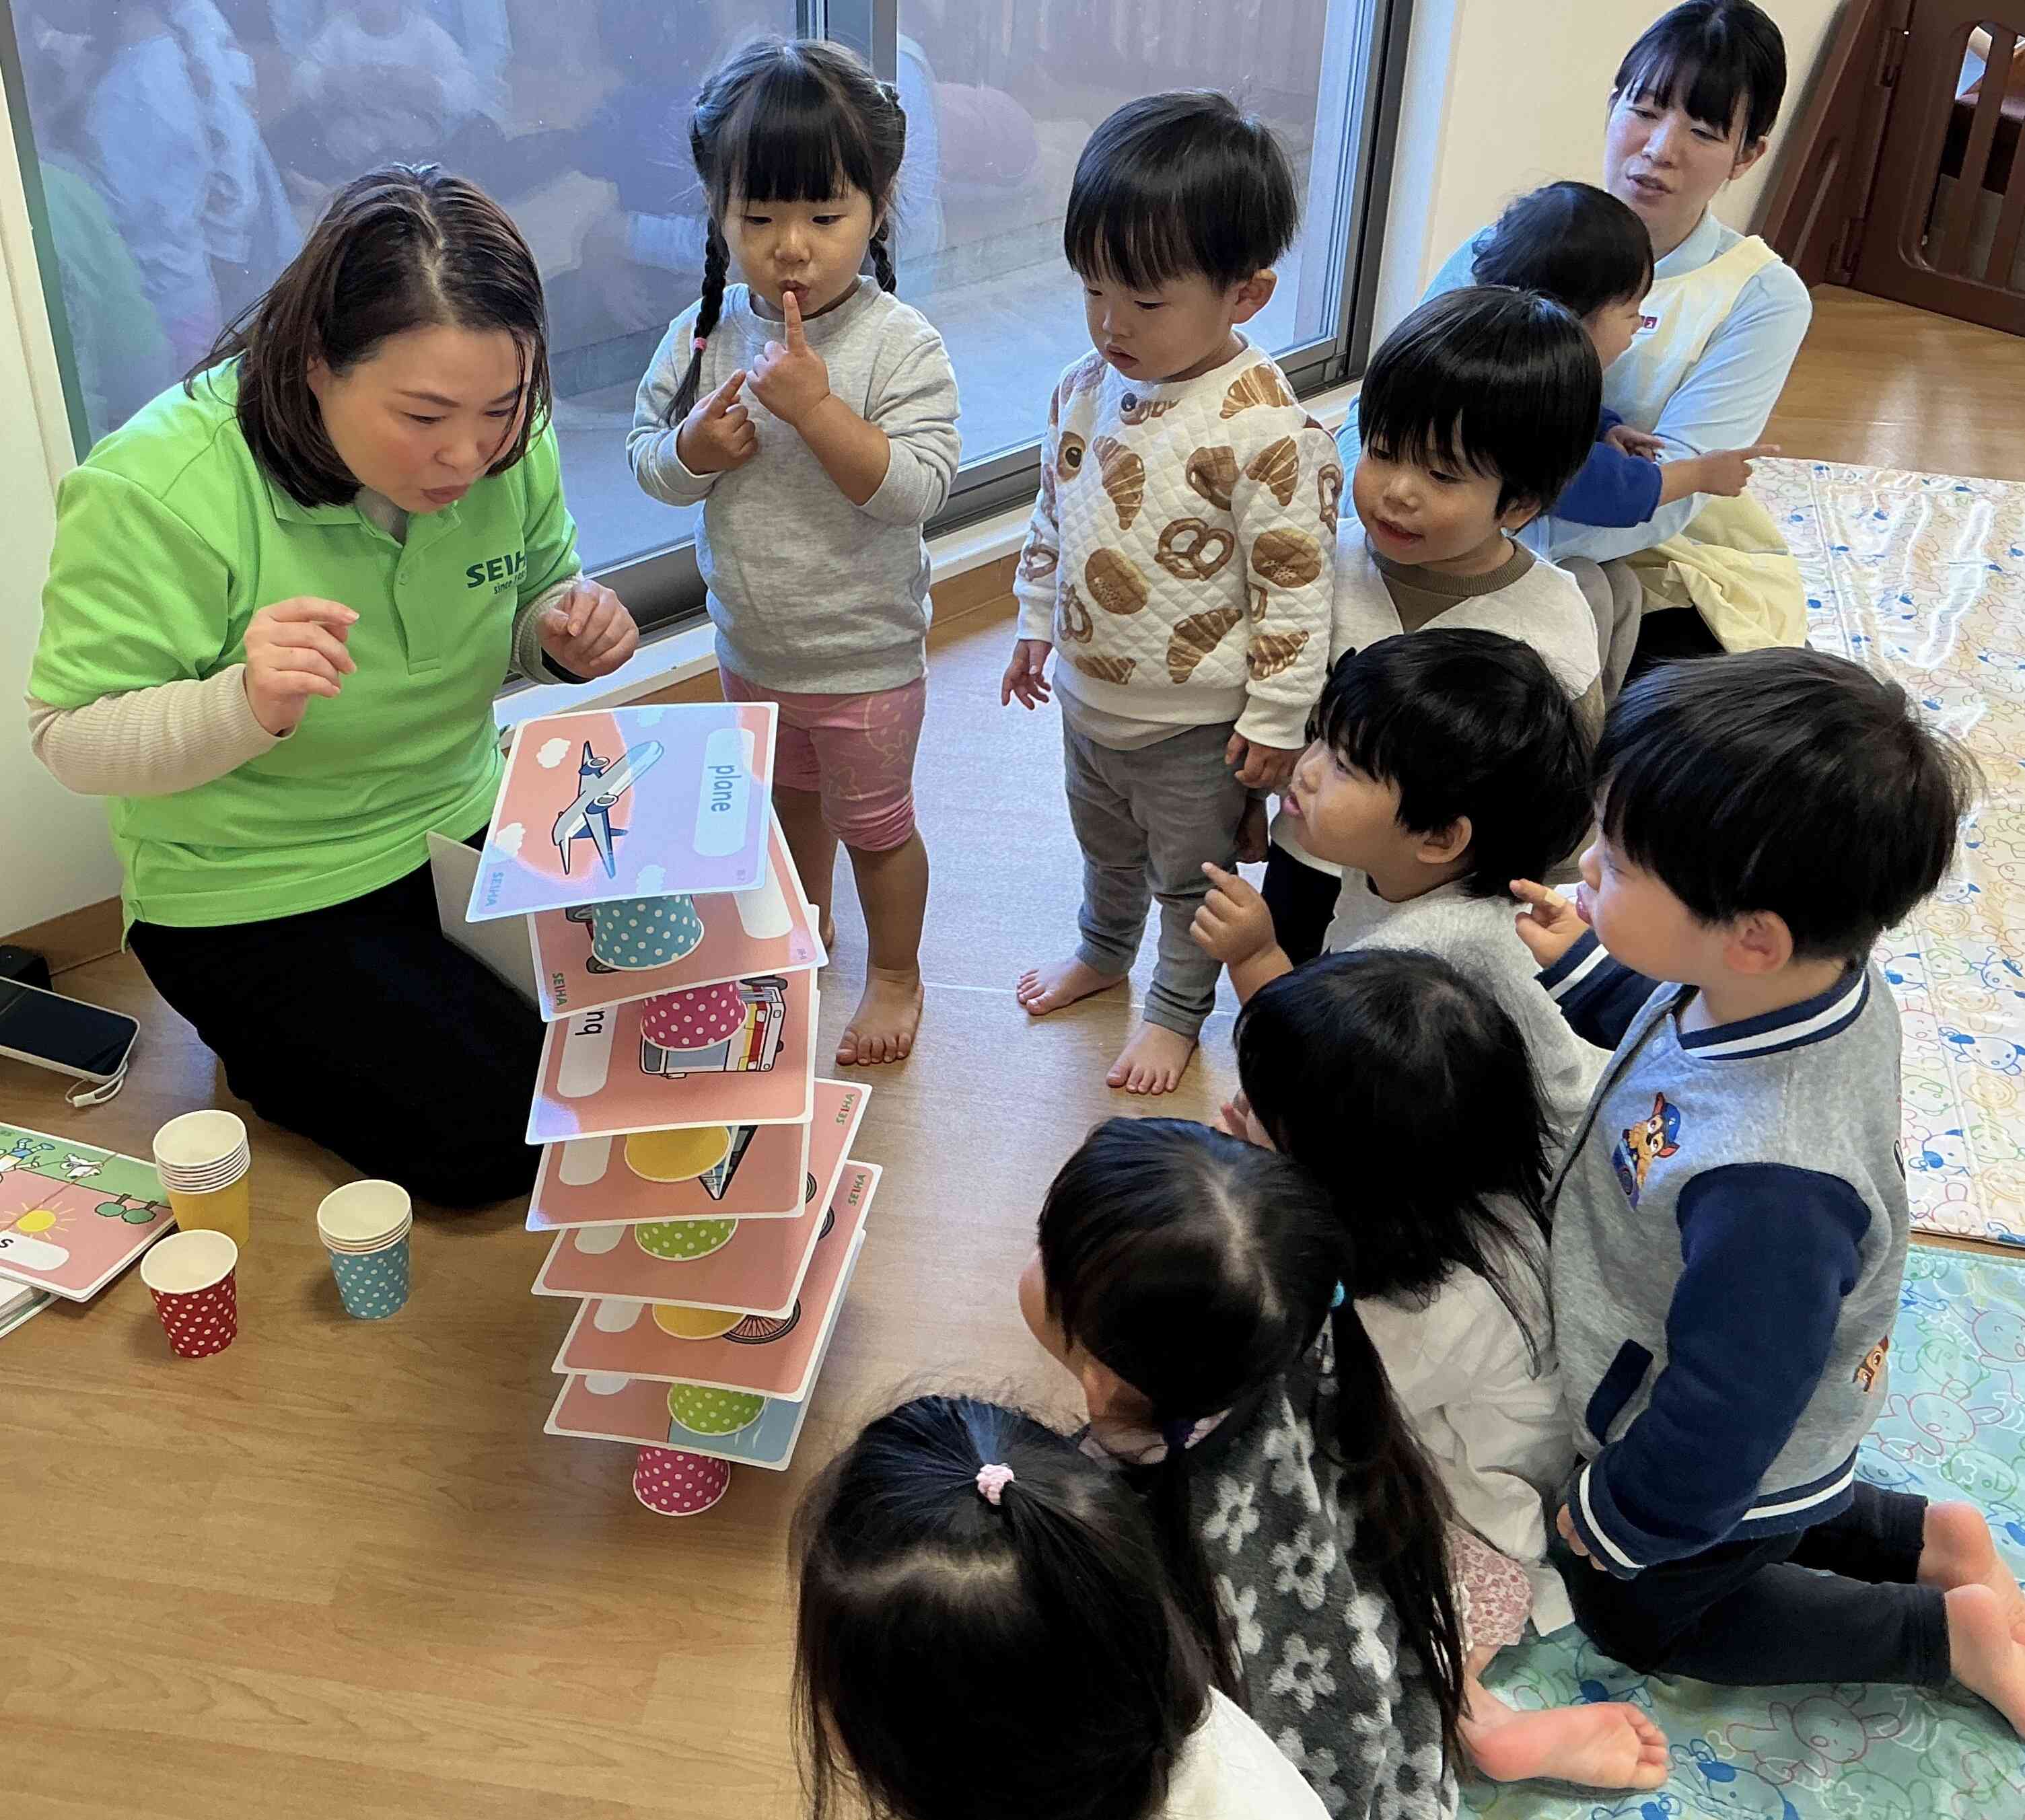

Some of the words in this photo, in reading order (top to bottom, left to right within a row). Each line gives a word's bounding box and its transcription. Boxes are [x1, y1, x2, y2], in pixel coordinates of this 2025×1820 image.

[466, 550, 526, 589] SEIH
[707, 765, 742, 811] plane
[485, 872, 503, 906] SEIHA
[552, 973, 567, 1006] SEIHA
[575, 1007, 605, 1035] bu
[836, 1093, 855, 1124] SEIHA
[848, 1174, 866, 1206] SEIHA
